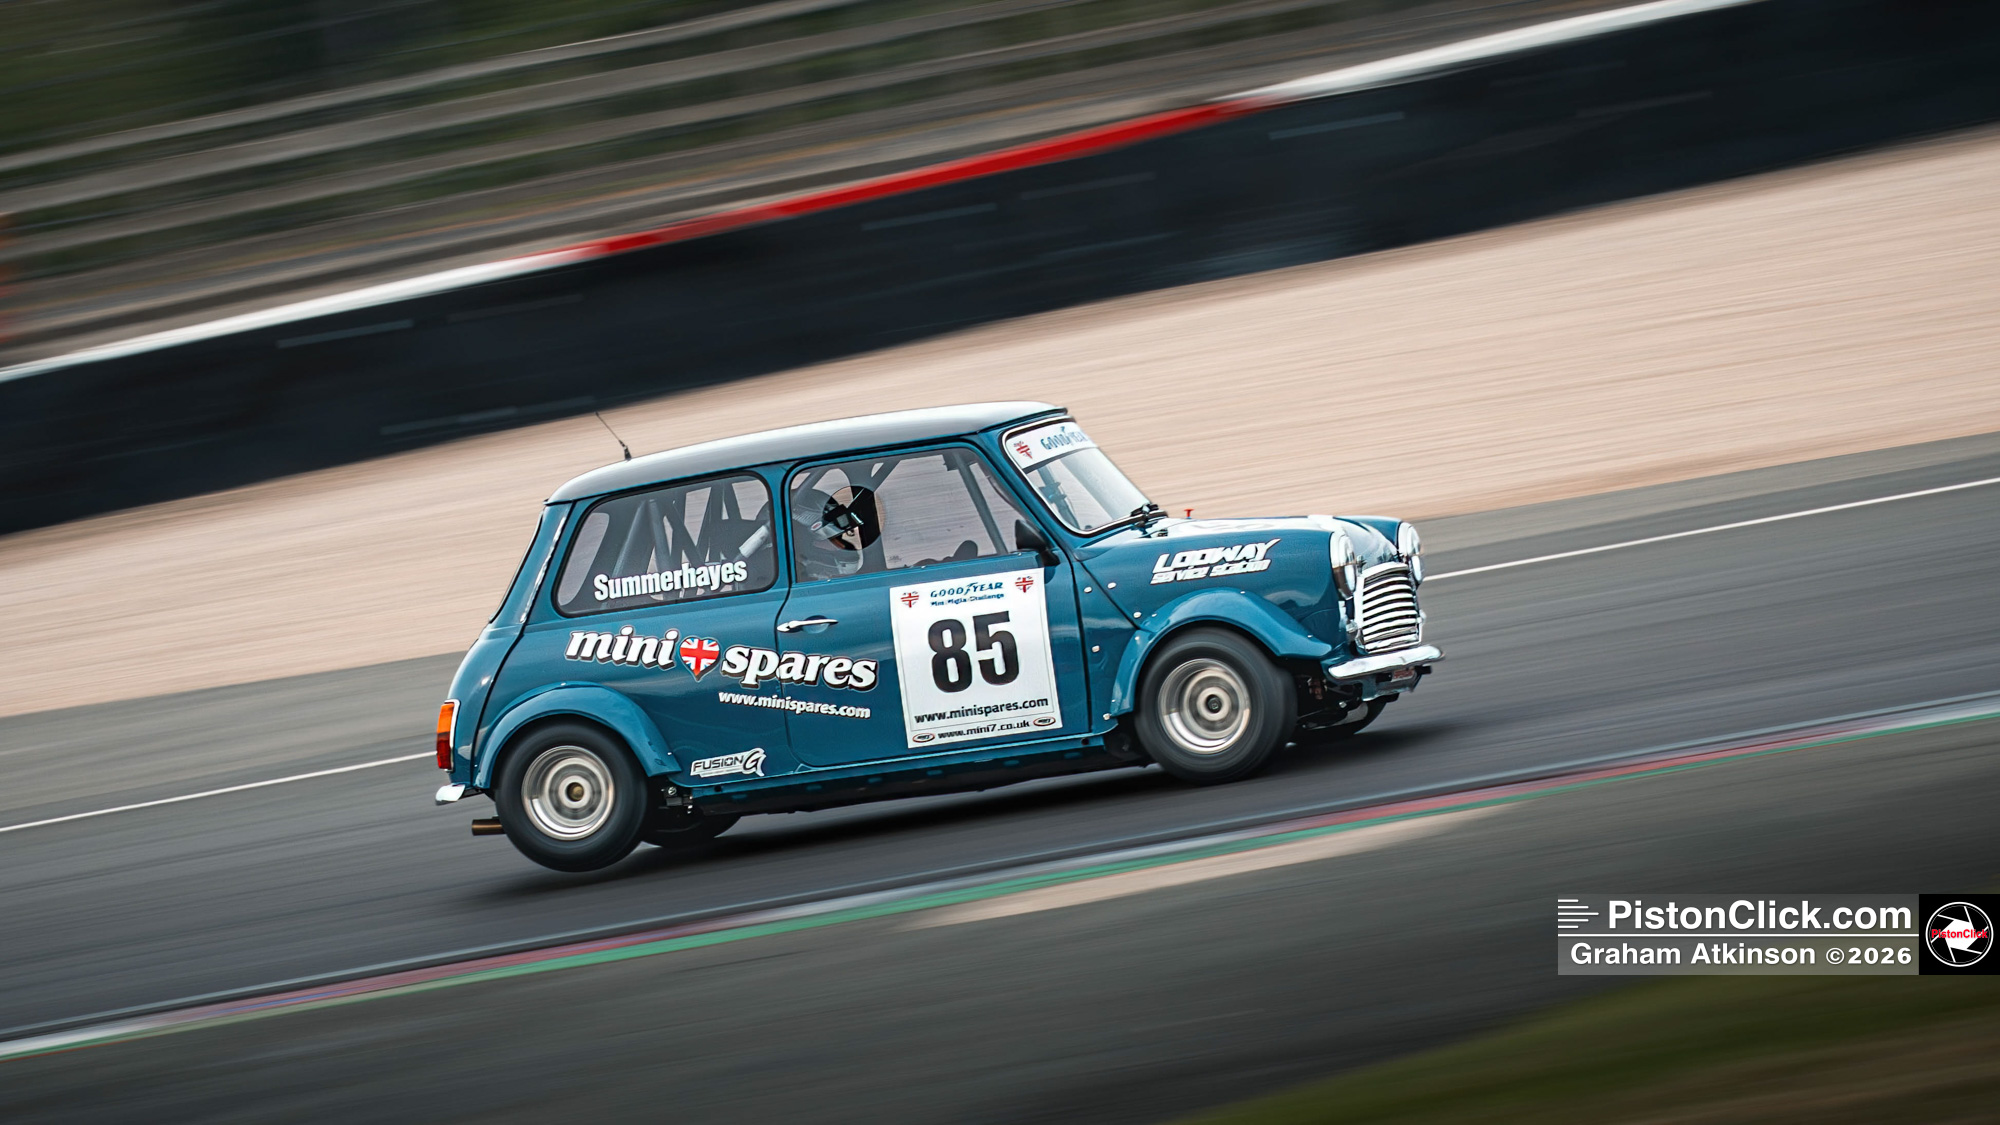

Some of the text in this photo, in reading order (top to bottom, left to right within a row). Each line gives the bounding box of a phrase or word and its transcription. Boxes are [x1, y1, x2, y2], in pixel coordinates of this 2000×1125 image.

[1152, 538, 1281, 574] LODWAY
[593, 560, 748, 601] Summerhayes
[930, 582, 1004, 598] GOODYEAR
[565, 626, 877, 691] mini spares
[928, 610, 1020, 693] 85
[718, 691, 871, 719] www.minispares.com
[914, 698, 1049, 723] www.minispares.com
[938, 720, 1030, 739] www.mini7.co.uk
